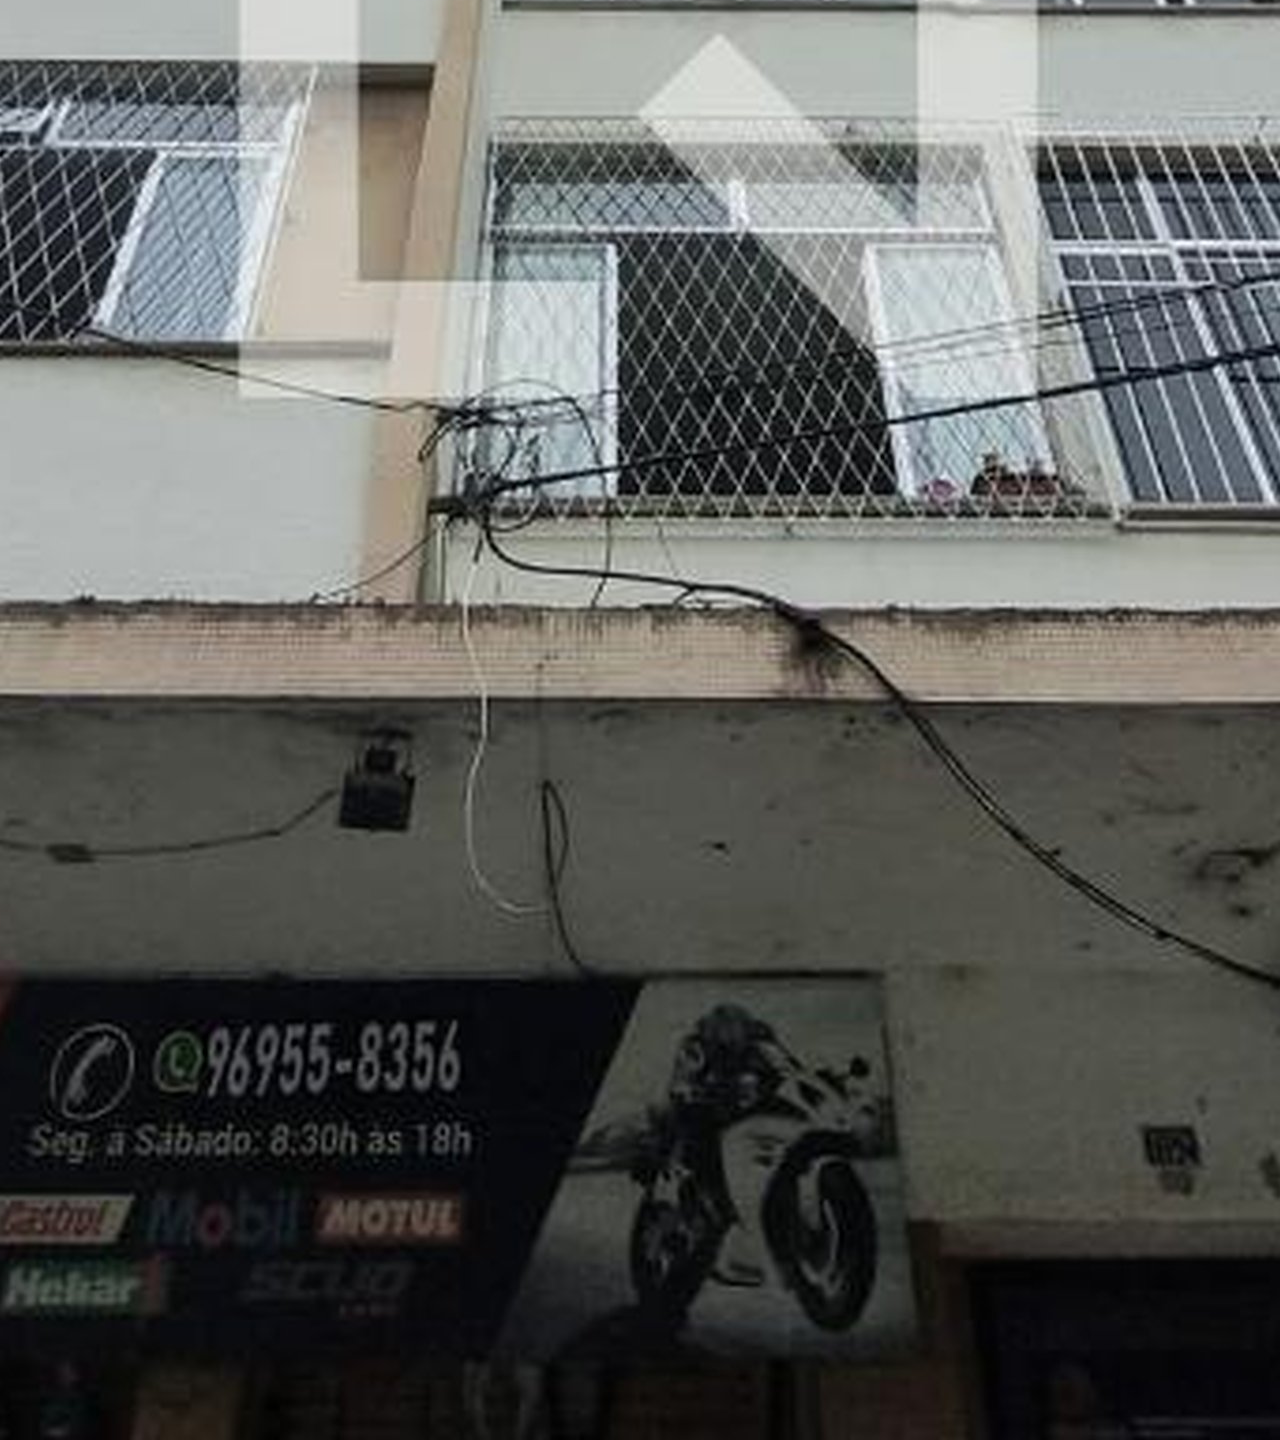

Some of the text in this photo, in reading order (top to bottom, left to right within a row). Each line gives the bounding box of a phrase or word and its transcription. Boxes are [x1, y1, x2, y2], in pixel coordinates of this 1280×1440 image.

[207, 1020, 463, 1097] 96955-8356
[269, 1121, 359, 1157] 8:30h
[411, 1121, 473, 1157] 18h
[144, 1185, 300, 1247] Mobil
[323, 1198, 460, 1236] MOTUL
